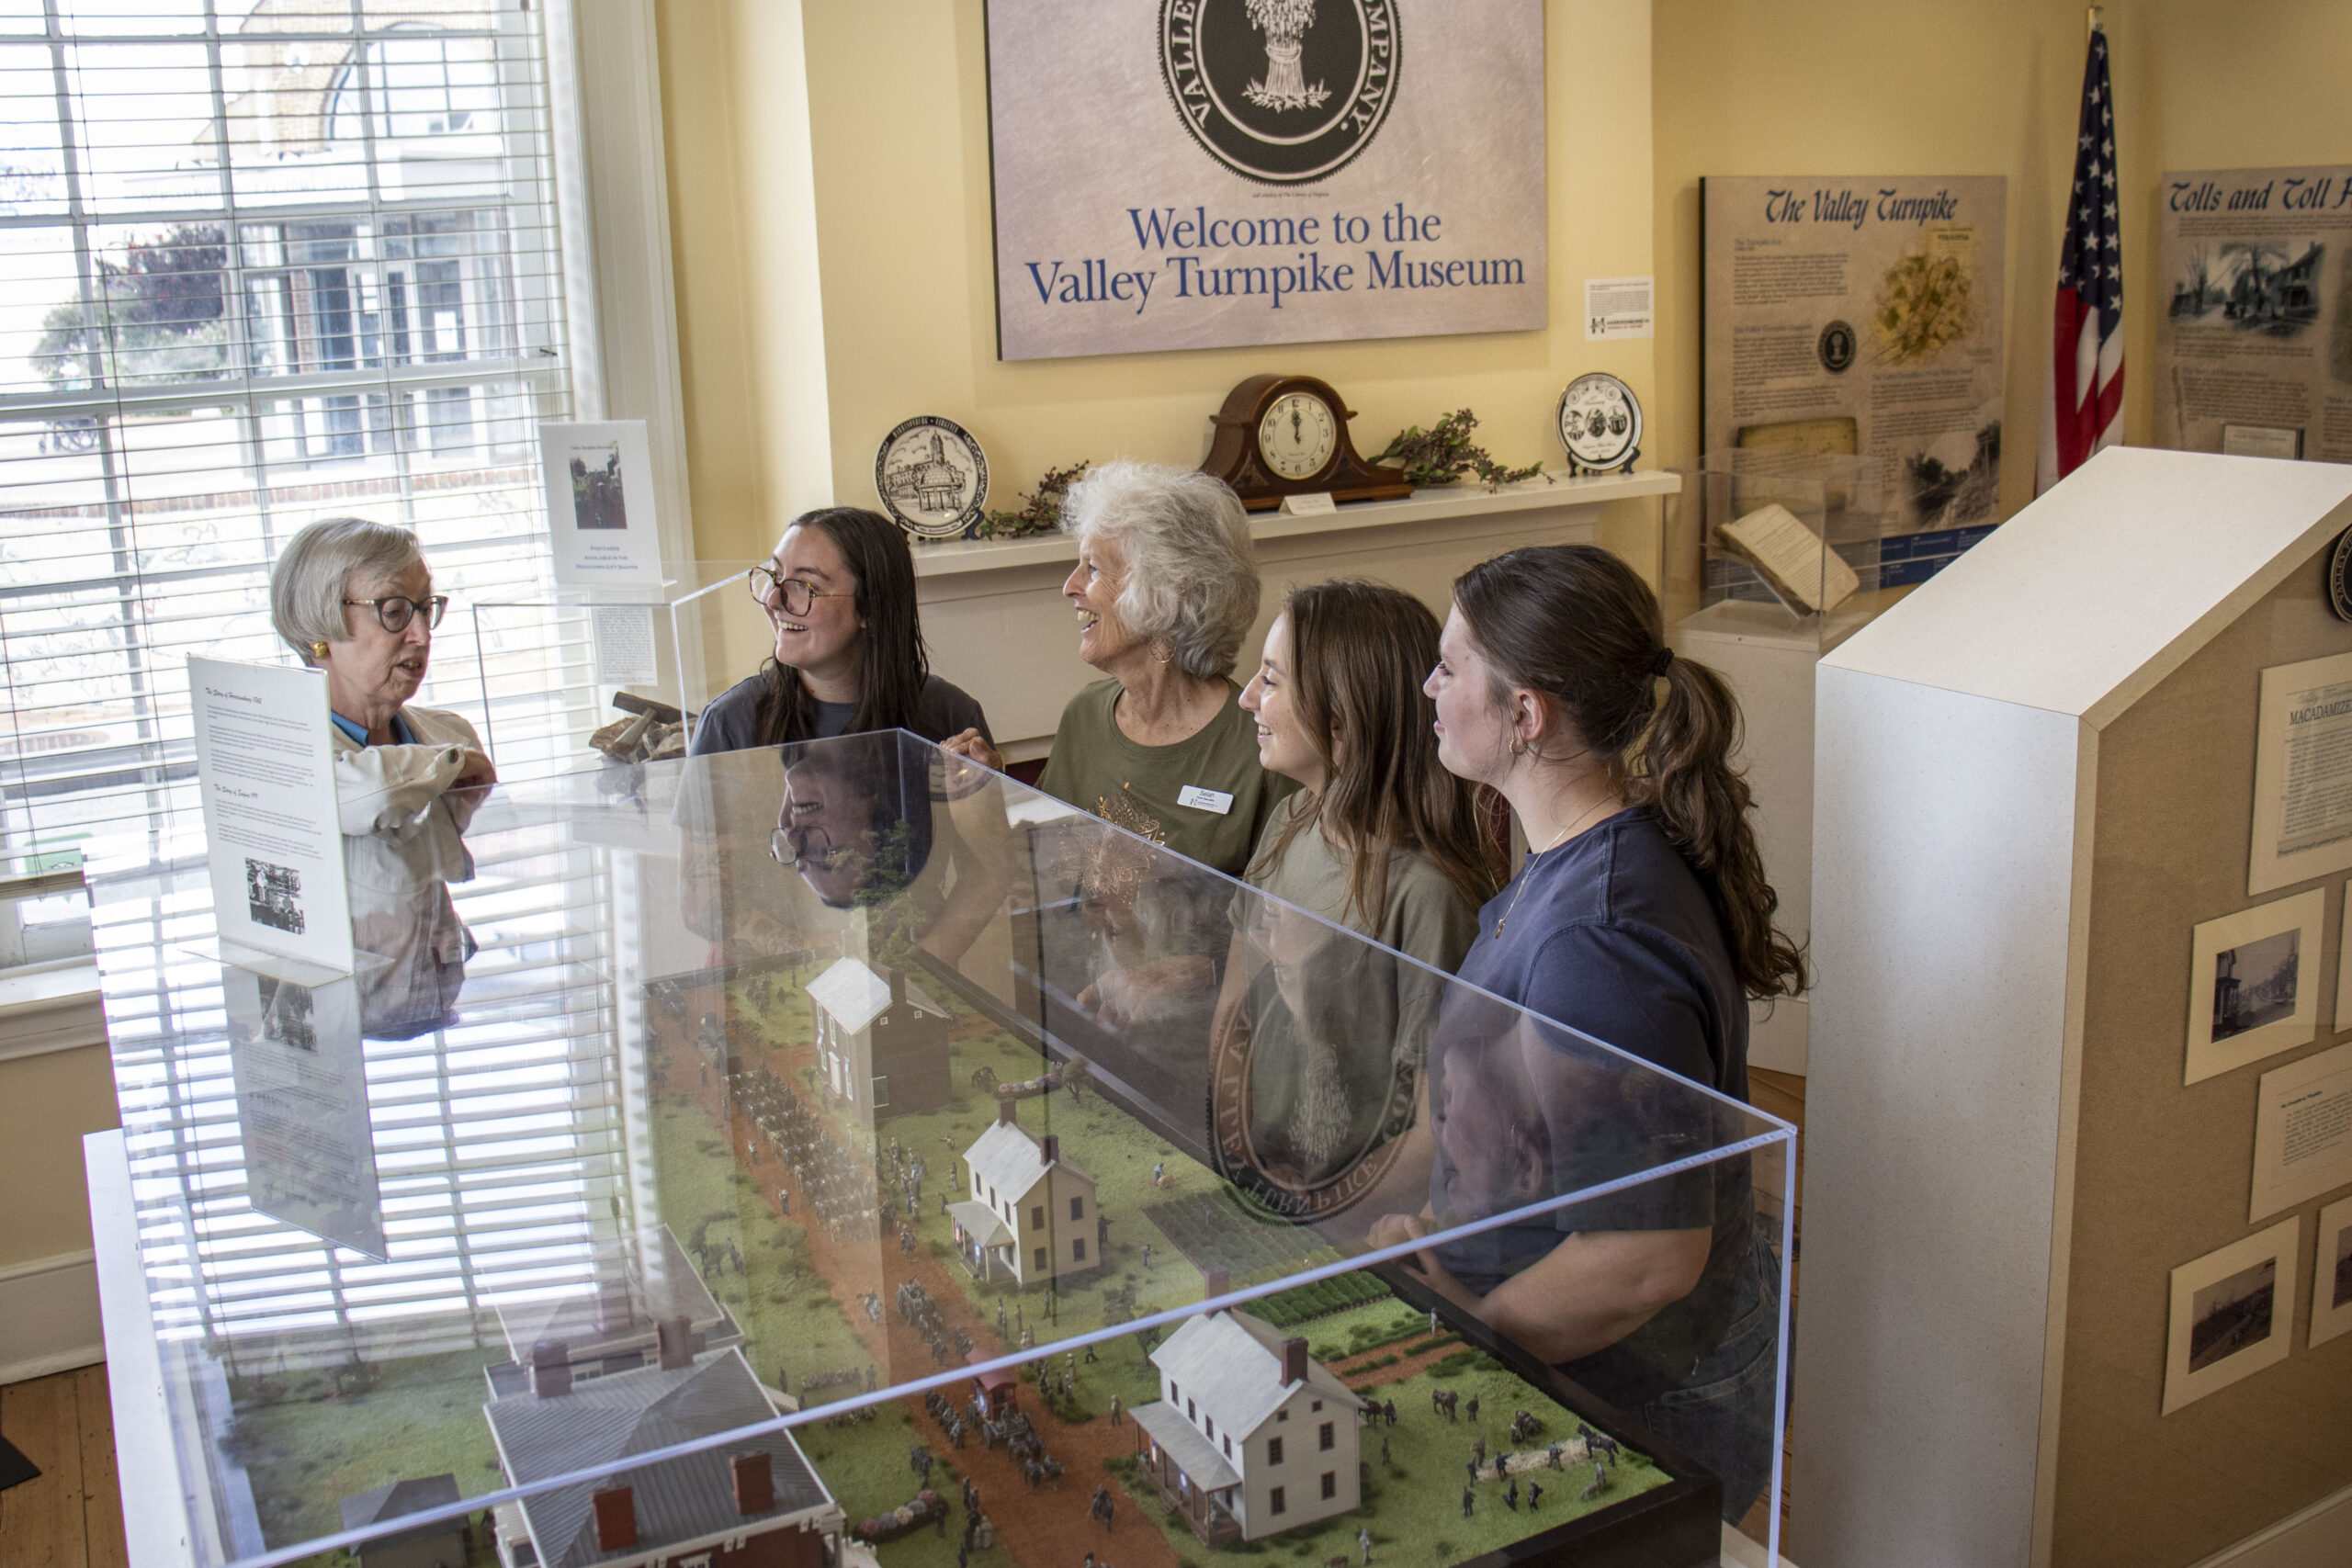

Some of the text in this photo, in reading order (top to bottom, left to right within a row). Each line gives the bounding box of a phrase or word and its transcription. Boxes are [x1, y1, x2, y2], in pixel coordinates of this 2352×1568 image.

[1340, 0, 1391, 135] MPANY.
[1766, 188, 1958, 231] The Valley Turnpike
[2170, 182, 2222, 211] Tolls
[2227, 180, 2274, 211] and
[2283, 178, 2332, 210] Toll
[1128, 203, 1442, 251] Welcome to the
[1025, 250, 1525, 315] Valley Turnpike Museum
